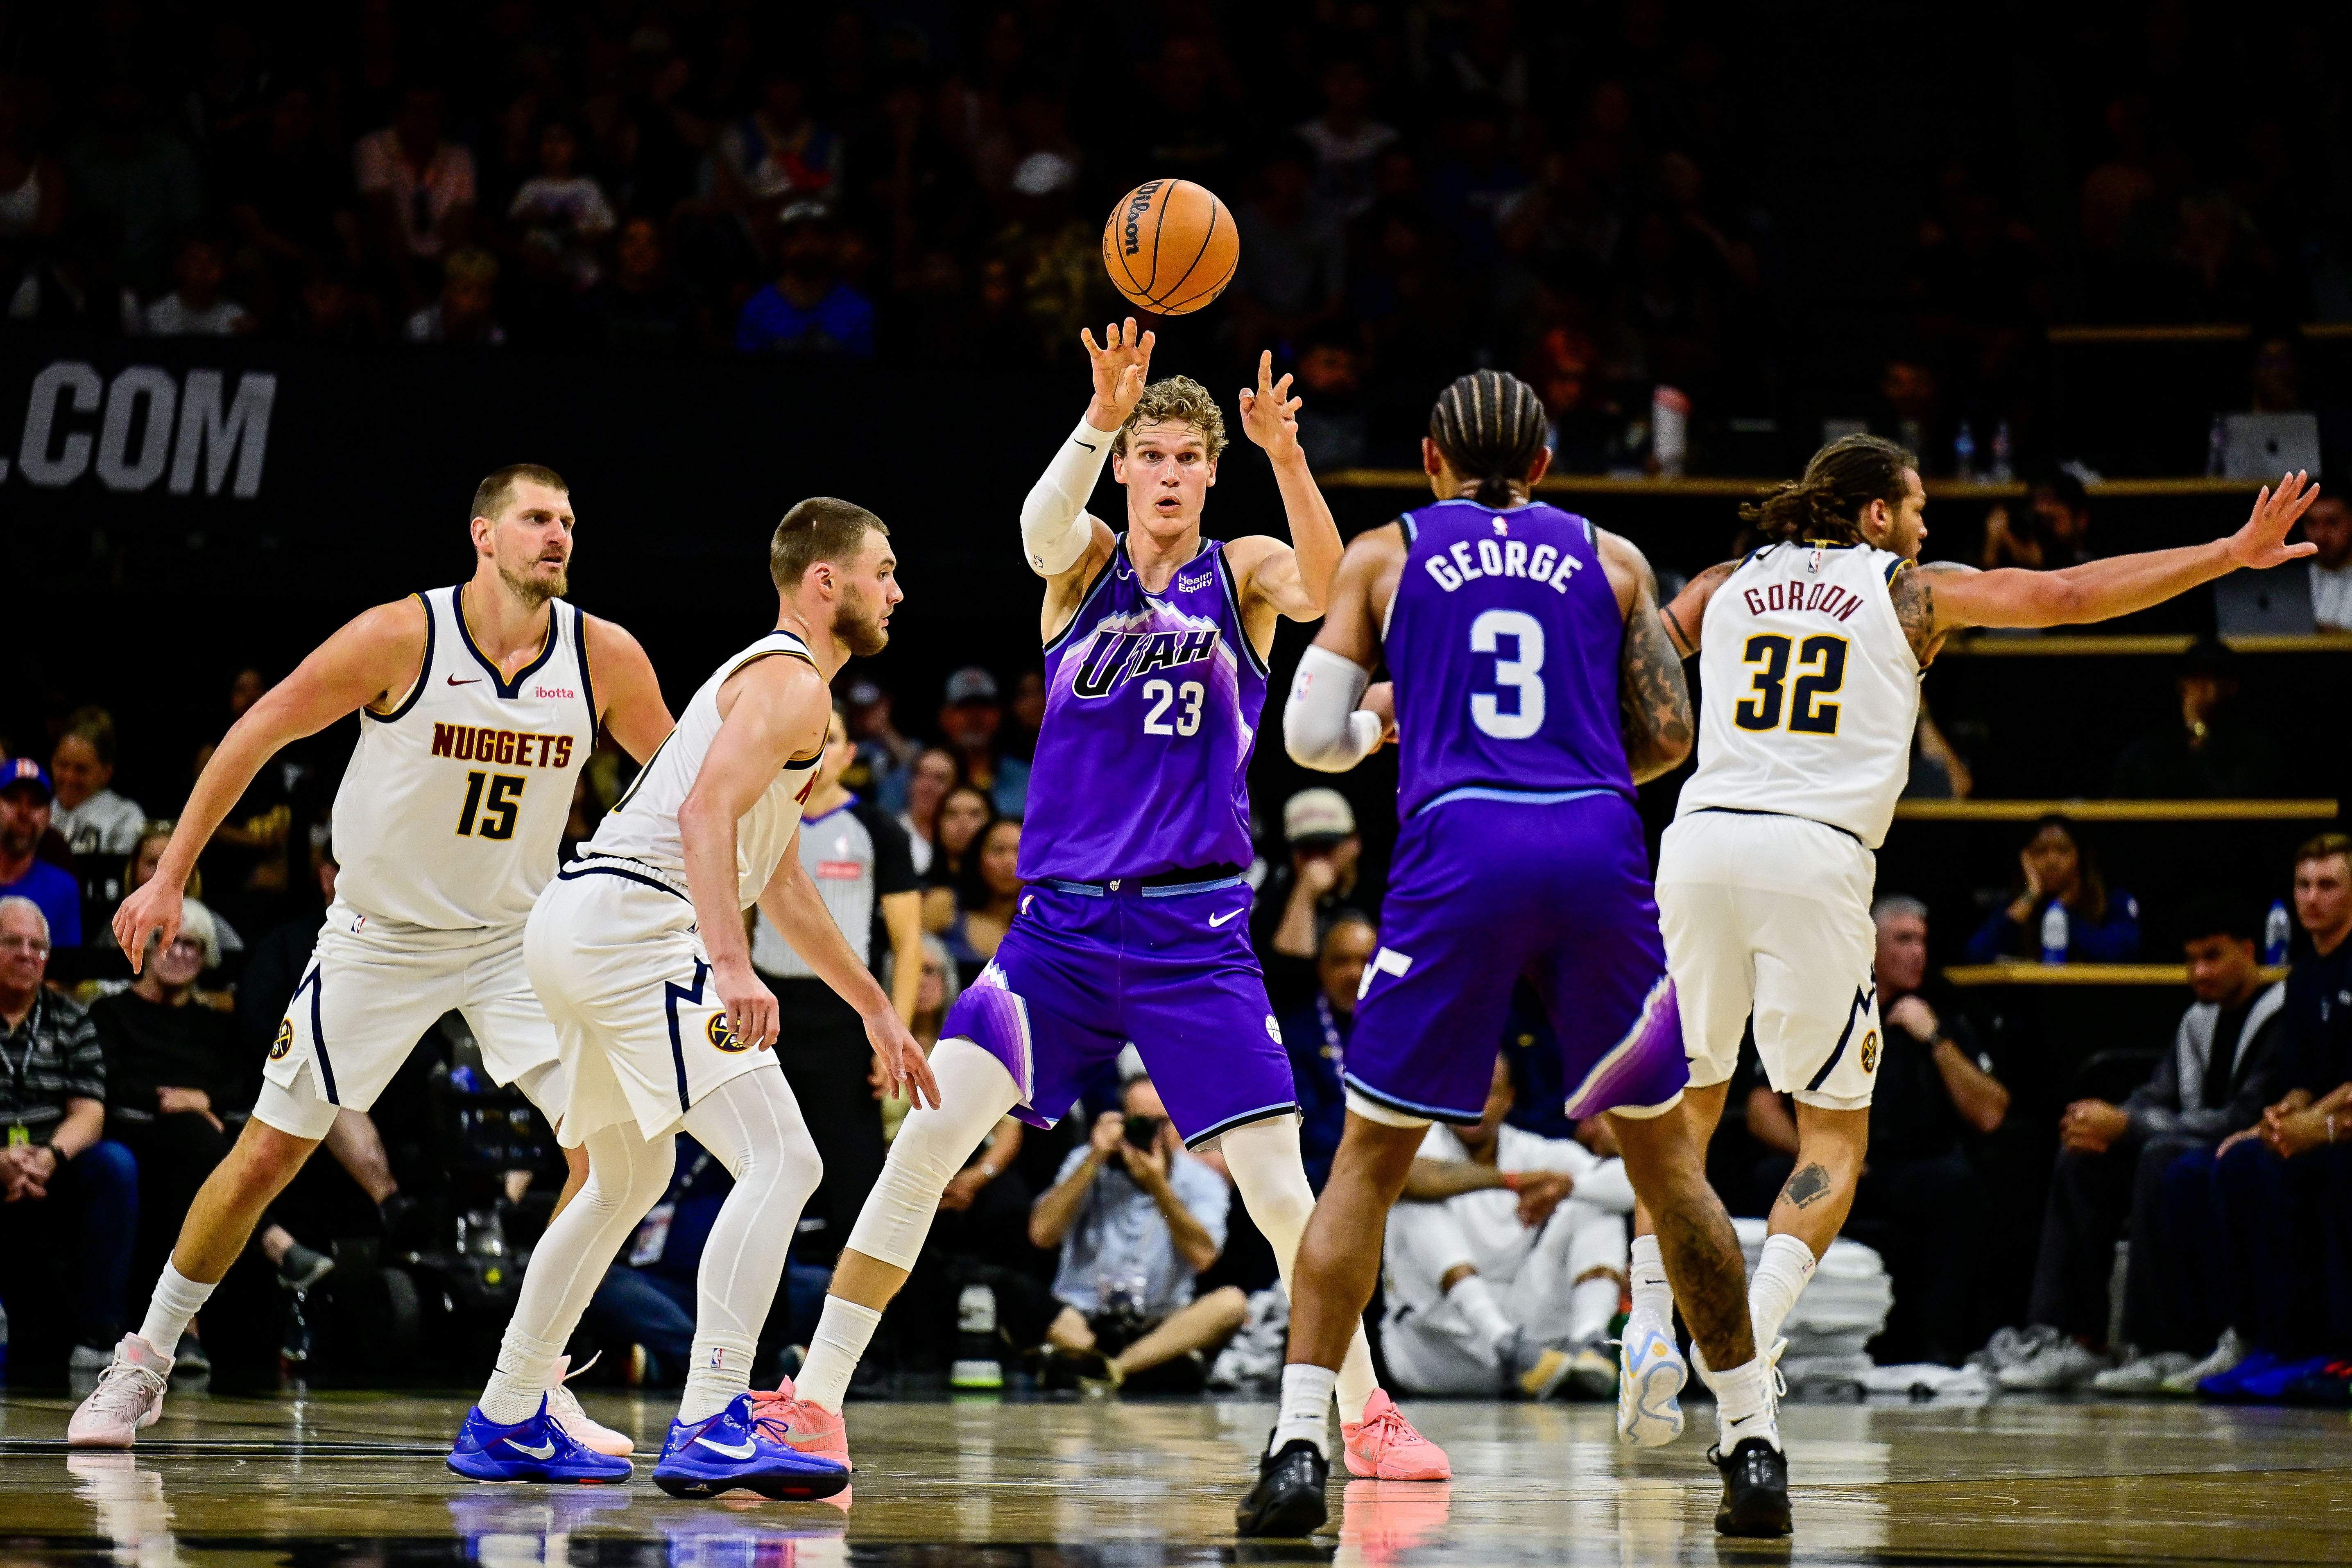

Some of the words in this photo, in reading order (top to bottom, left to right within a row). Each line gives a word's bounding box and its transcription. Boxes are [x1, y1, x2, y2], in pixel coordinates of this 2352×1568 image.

[1125, 181, 1165, 256] Wilson
[1179, 571, 1212, 585] Health
[1179, 577, 1213, 594] Equity
[1424, 539, 1583, 595] GEORGE
[1743, 580, 1863, 623] GORDON
[536, 686, 574, 699] ibotta
[1071, 629, 1221, 700] UTAH
[1468, 608, 1546, 740] 3
[1733, 632, 1850, 736] 32
[1142, 678, 1205, 738] 23
[431, 722, 574, 768] NUGGETS
[456, 770, 527, 841] 15
